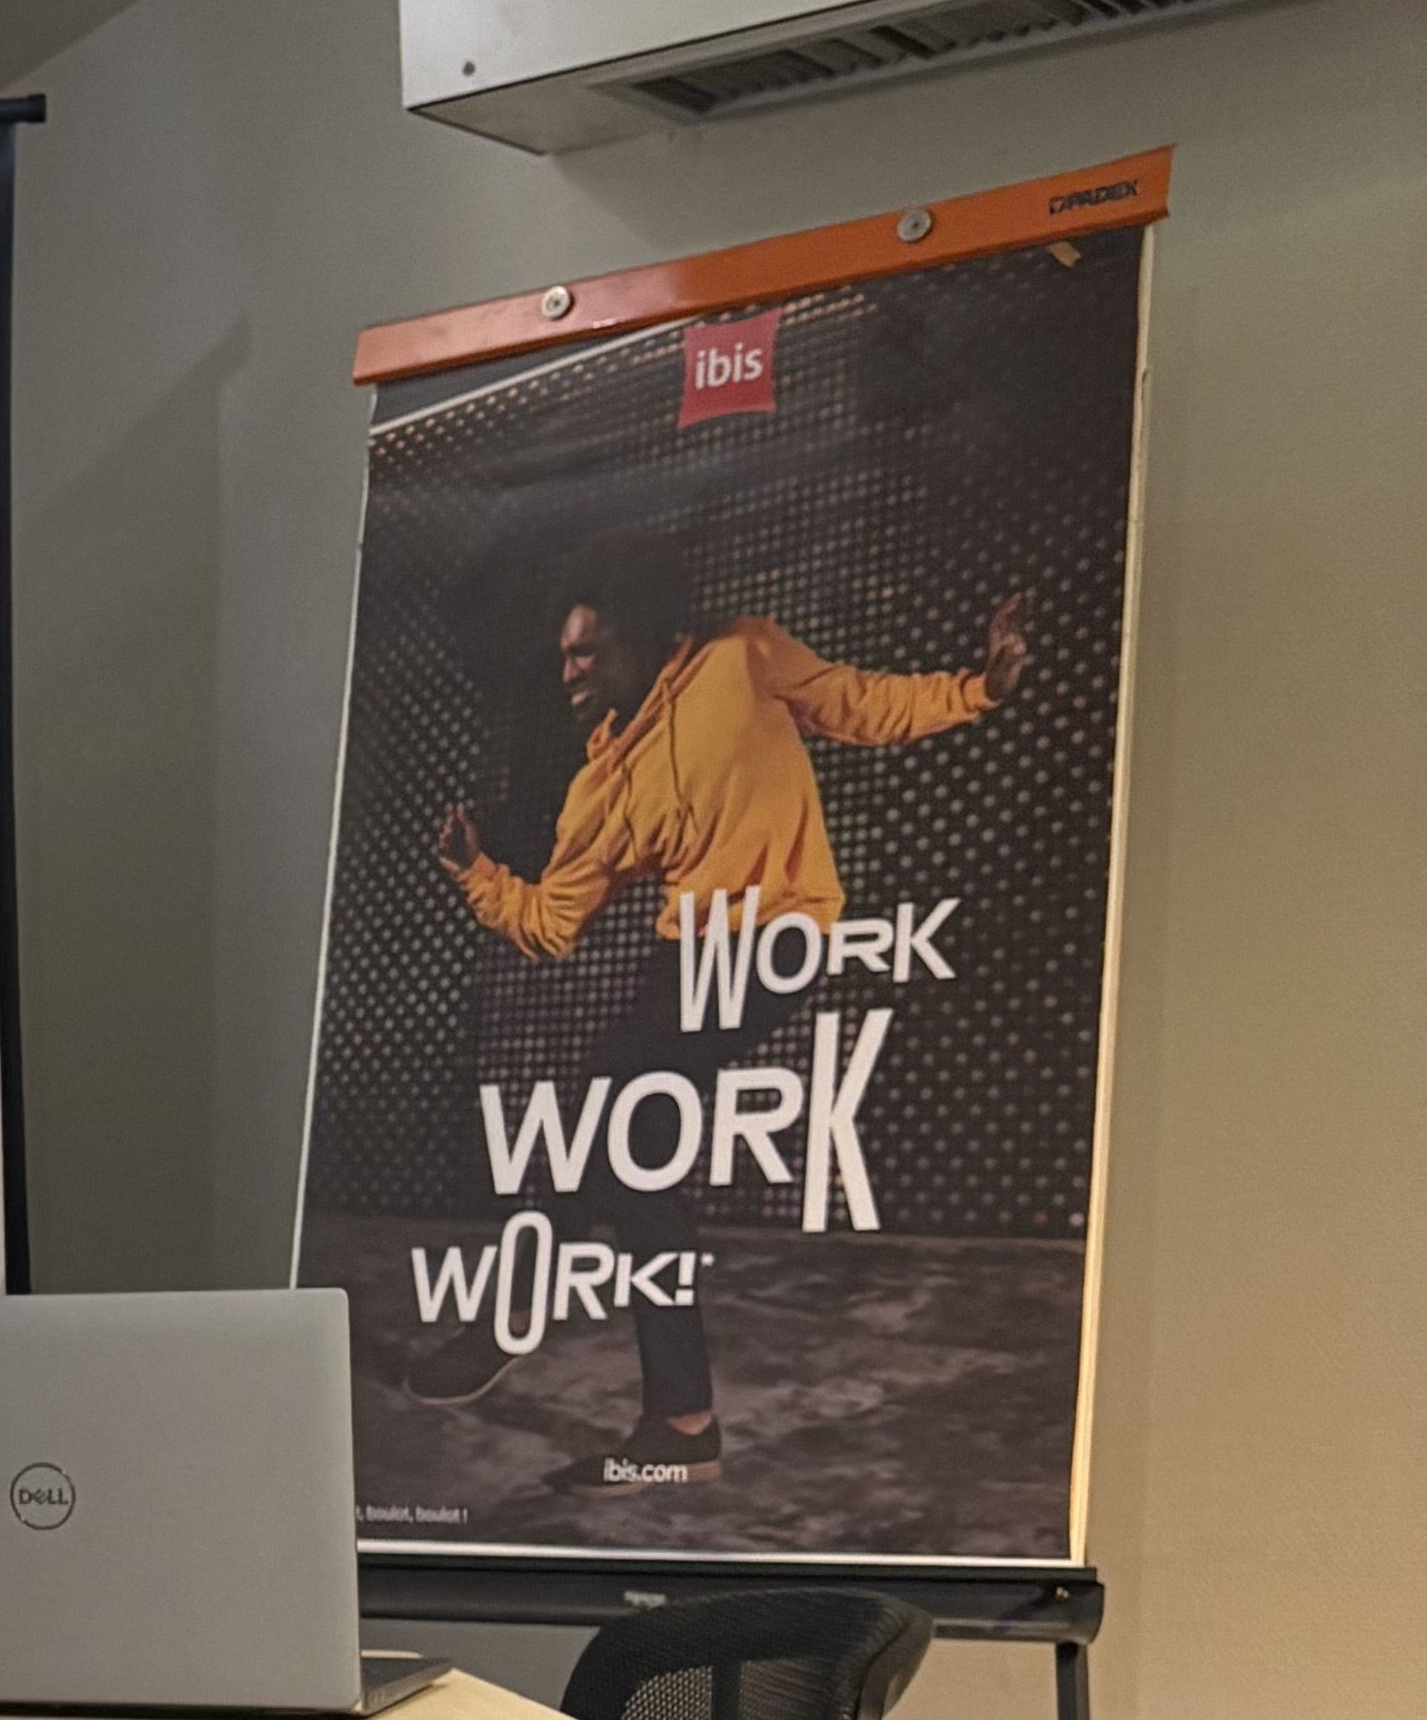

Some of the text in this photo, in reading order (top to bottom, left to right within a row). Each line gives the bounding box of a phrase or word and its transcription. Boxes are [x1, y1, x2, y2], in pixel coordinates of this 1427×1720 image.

[693, 343, 766, 391] ibis
[678, 885, 961, 1033] WORK
[478, 1008, 894, 1233] WORK
[603, 1458, 688, 1483] ibis.com
[18, 1488, 69, 1505] DELL
